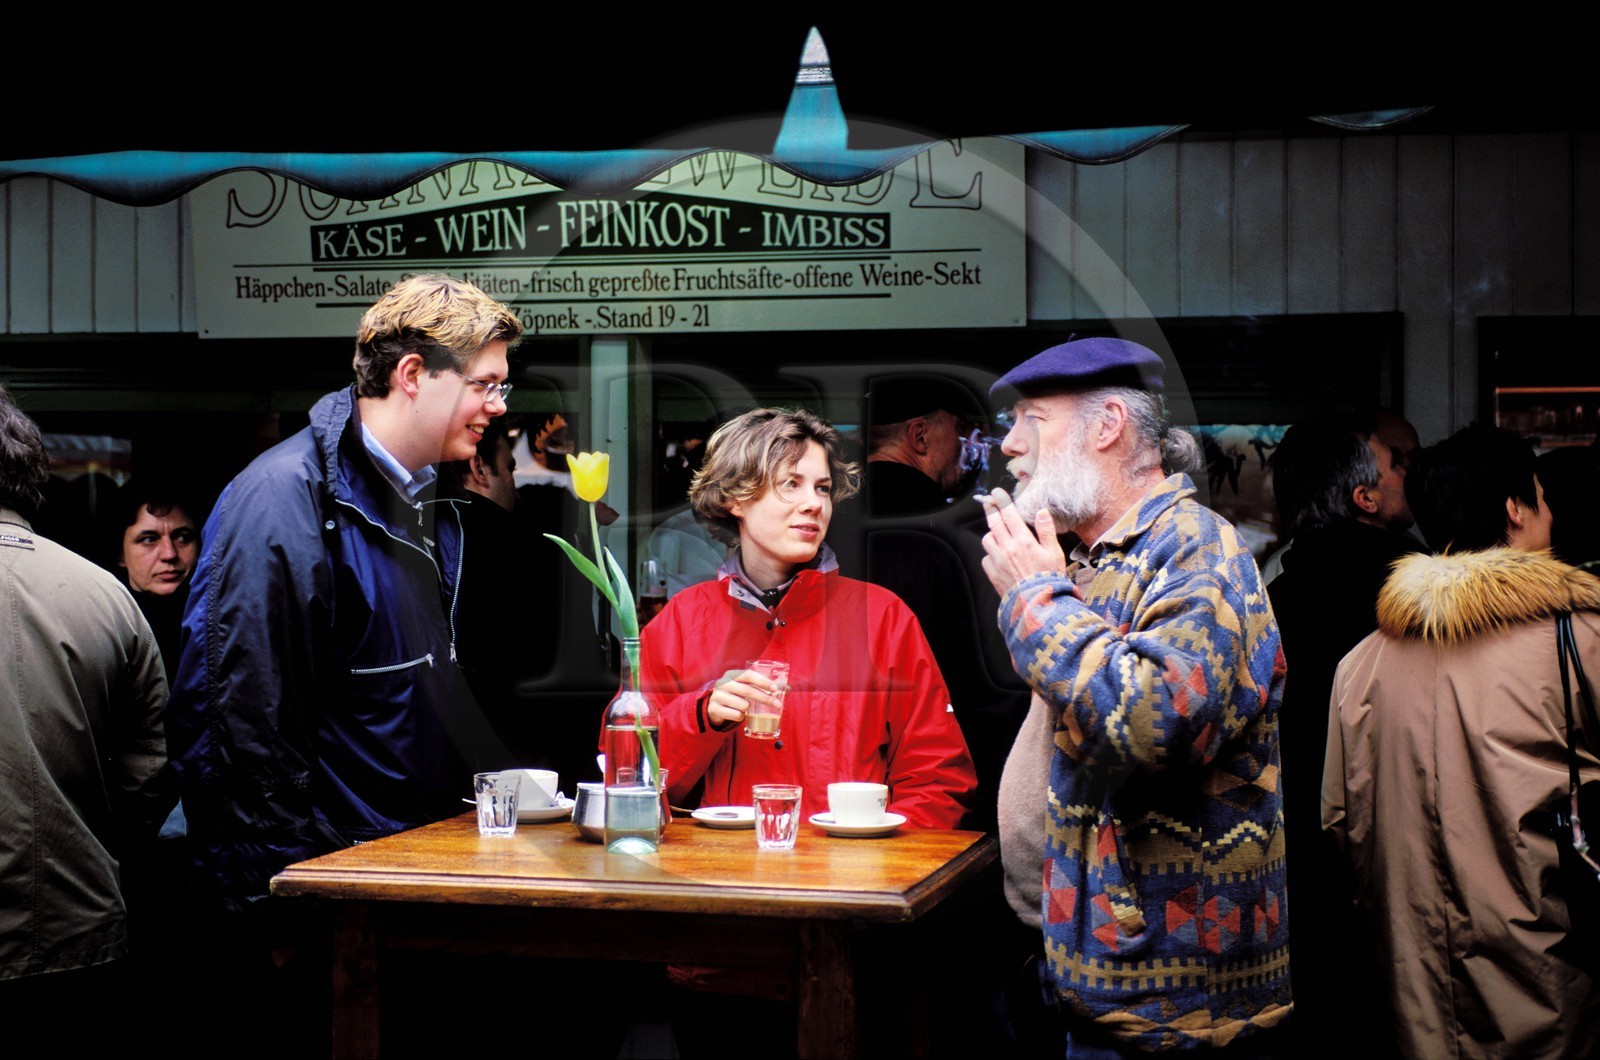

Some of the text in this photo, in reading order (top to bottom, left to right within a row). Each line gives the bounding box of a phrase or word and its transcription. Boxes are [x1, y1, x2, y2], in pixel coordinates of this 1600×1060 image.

[317, 223, 407, 259] KÄSE
[434, 205, 527, 253] WEIN
[557, 198, 731, 249] FEINKOST
[761, 211, 886, 248] IMBISS
[588, 267, 671, 298] gepreßte
[859, 261, 983, 289] Weine-Sekt
[597, 305, 653, 329] Stand
[658, 304, 676, 328] 19
[693, 303, 711, 327] 21
